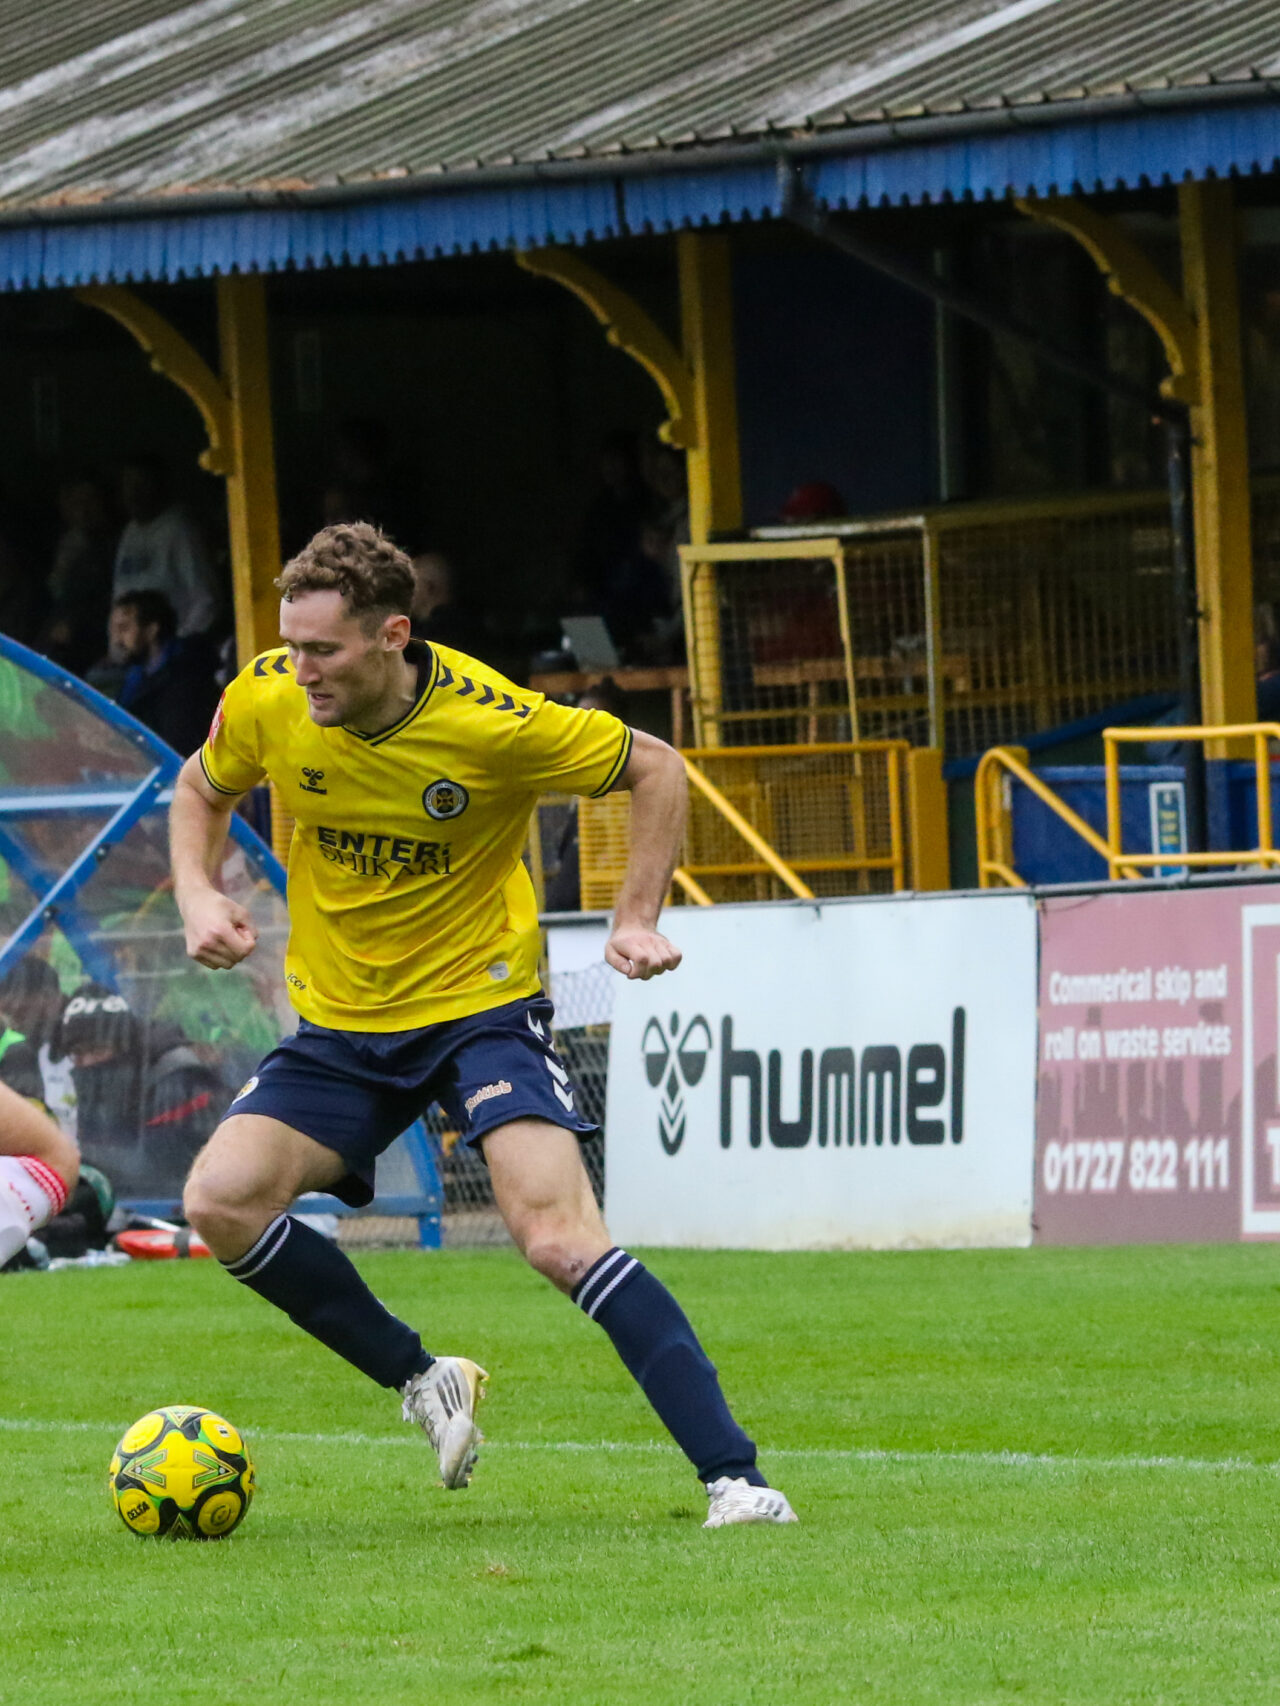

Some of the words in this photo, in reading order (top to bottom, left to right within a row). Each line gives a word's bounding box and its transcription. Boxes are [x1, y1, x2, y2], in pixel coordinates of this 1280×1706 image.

[1154, 964, 1193, 1006] skip
[1194, 963, 1228, 999] and
[1045, 1026, 1075, 1060] roll
[1077, 1030, 1102, 1060] on
[1104, 1024, 1160, 1058] waste
[1162, 1020, 1232, 1057] services
[720, 1006, 966, 1149] hummel
[1043, 1140, 1125, 1193] 01727
[1128, 1138, 1179, 1190] 822
[1182, 1137, 1230, 1190] 111
